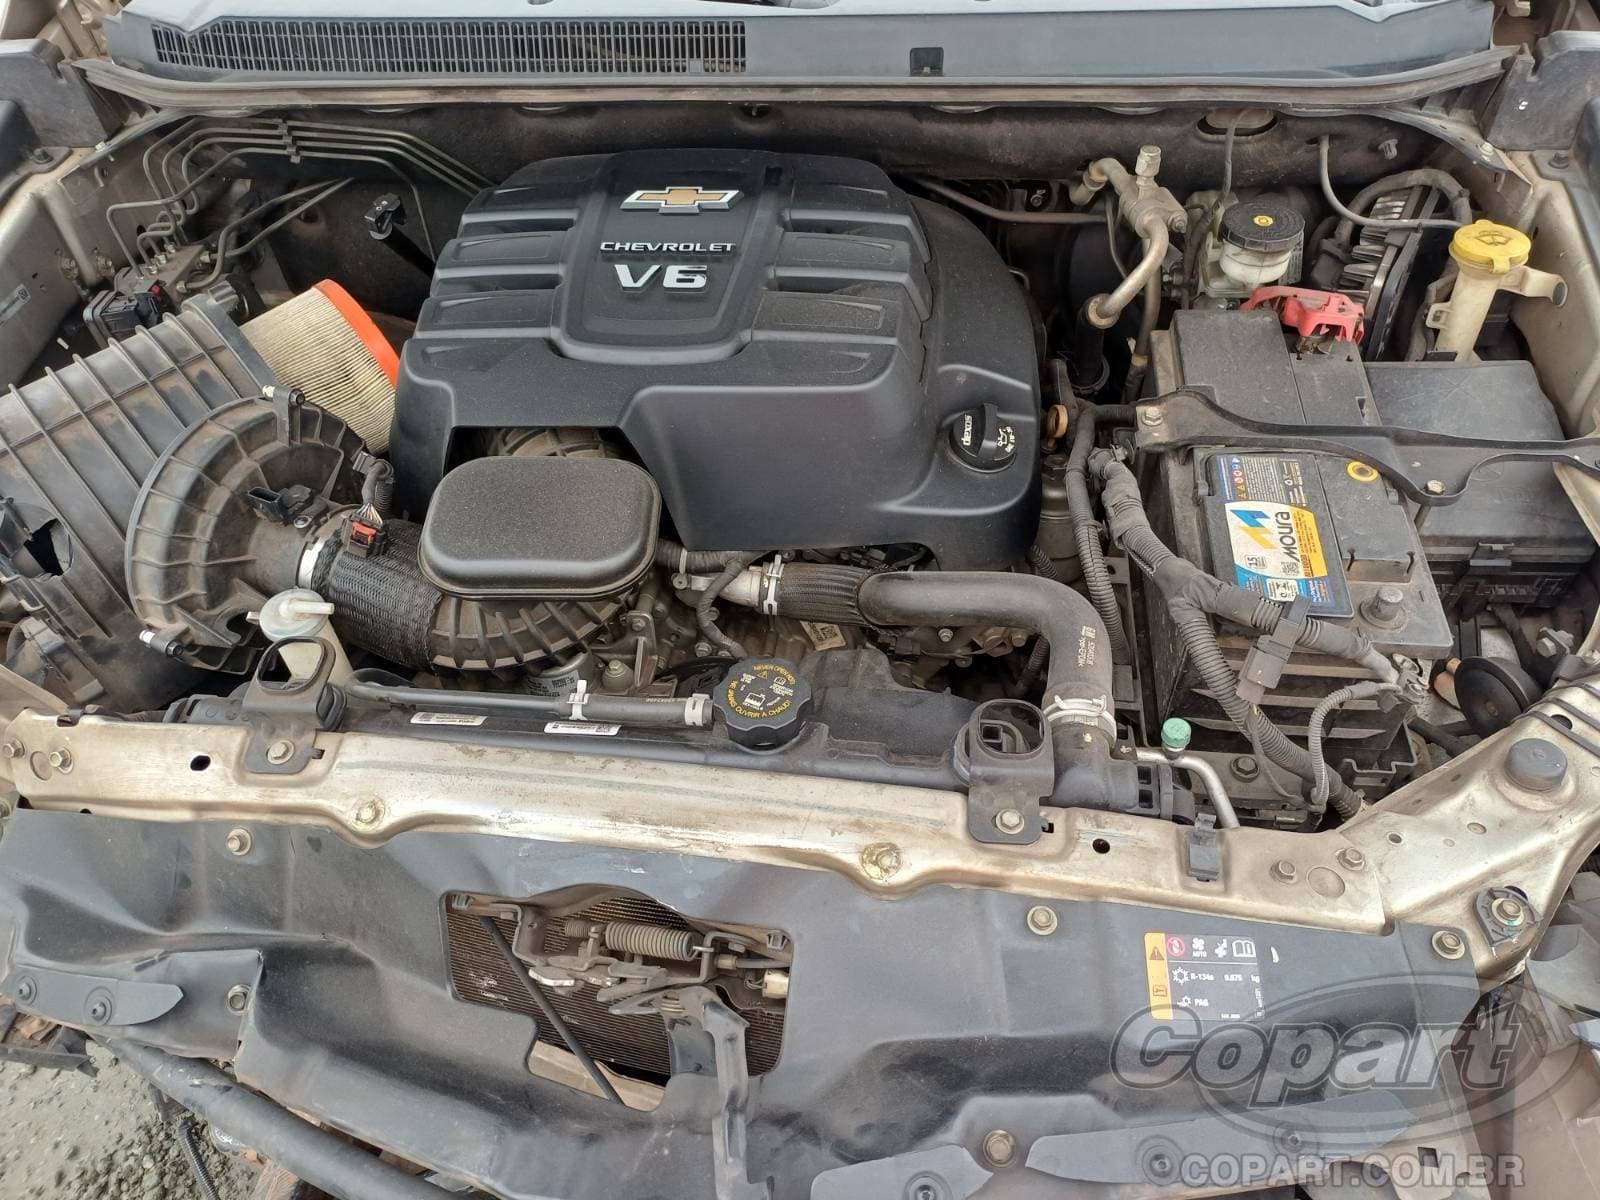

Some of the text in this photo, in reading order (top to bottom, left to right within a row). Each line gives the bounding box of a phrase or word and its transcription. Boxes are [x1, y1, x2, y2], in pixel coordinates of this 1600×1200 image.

[600, 241, 737, 252] CHEVROLET
[614, 264, 708, 290] V6
[961, 415, 973, 446] dexos
